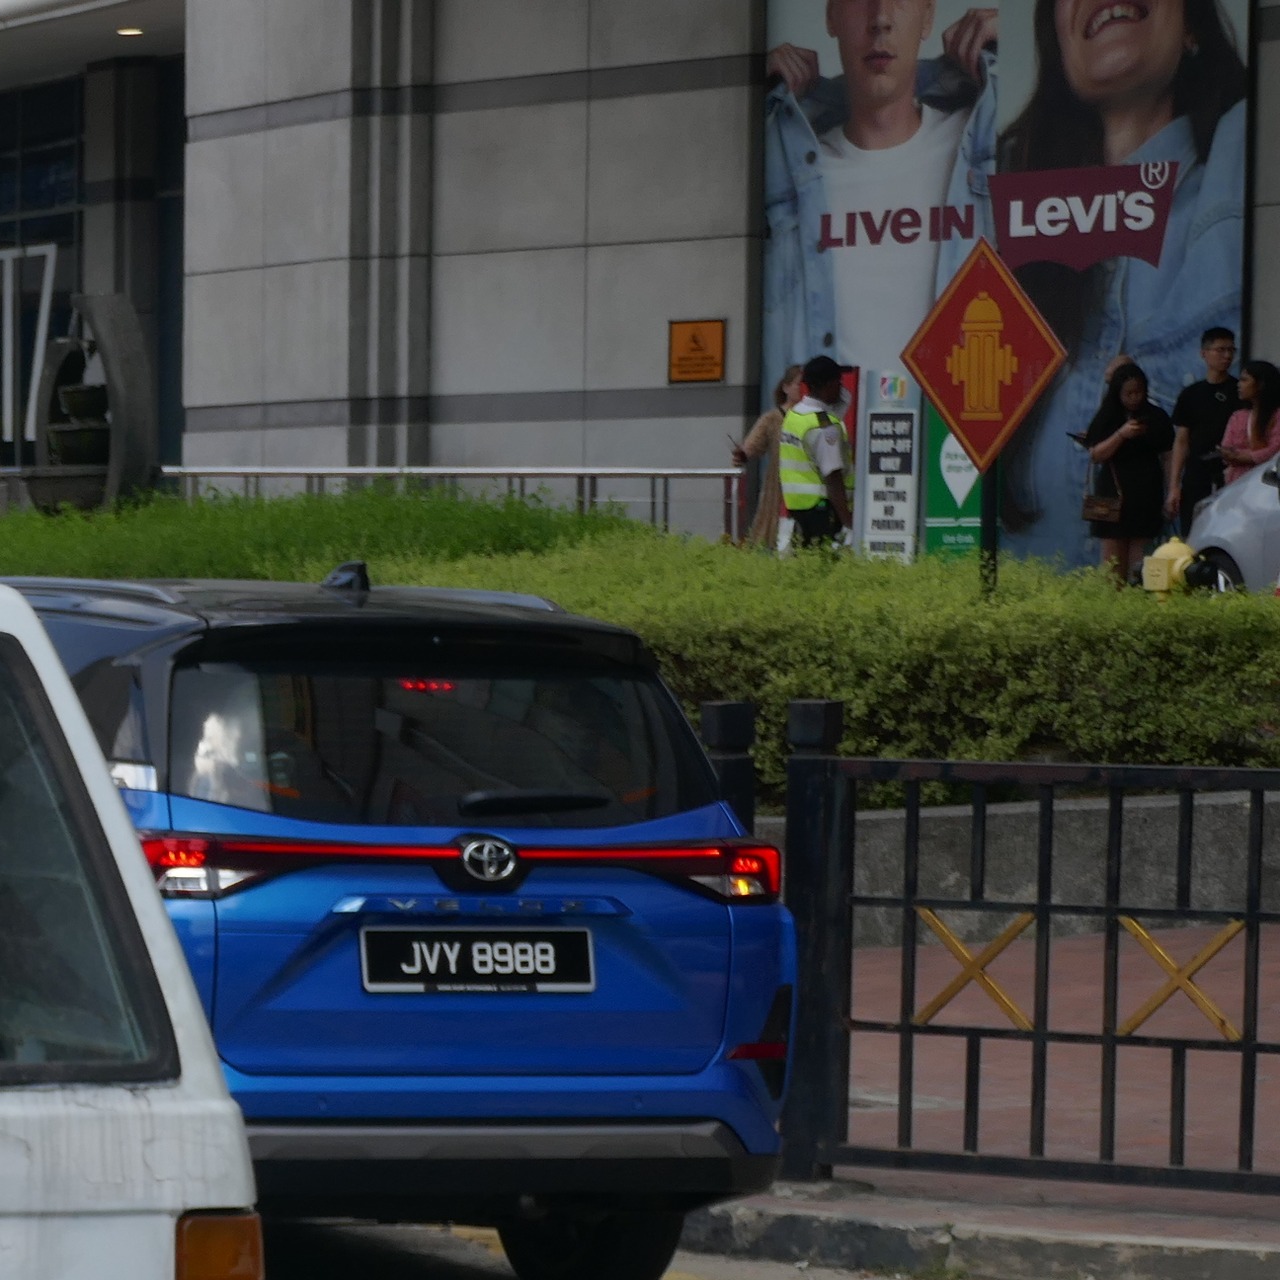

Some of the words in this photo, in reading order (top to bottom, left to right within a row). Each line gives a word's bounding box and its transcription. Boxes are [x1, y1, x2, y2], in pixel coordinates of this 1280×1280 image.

[929, 204, 974, 242] IN
[871, 519, 905, 531] PARKING
[400, 941, 461, 975] JVY
[472, 941, 557, 975] 8988
